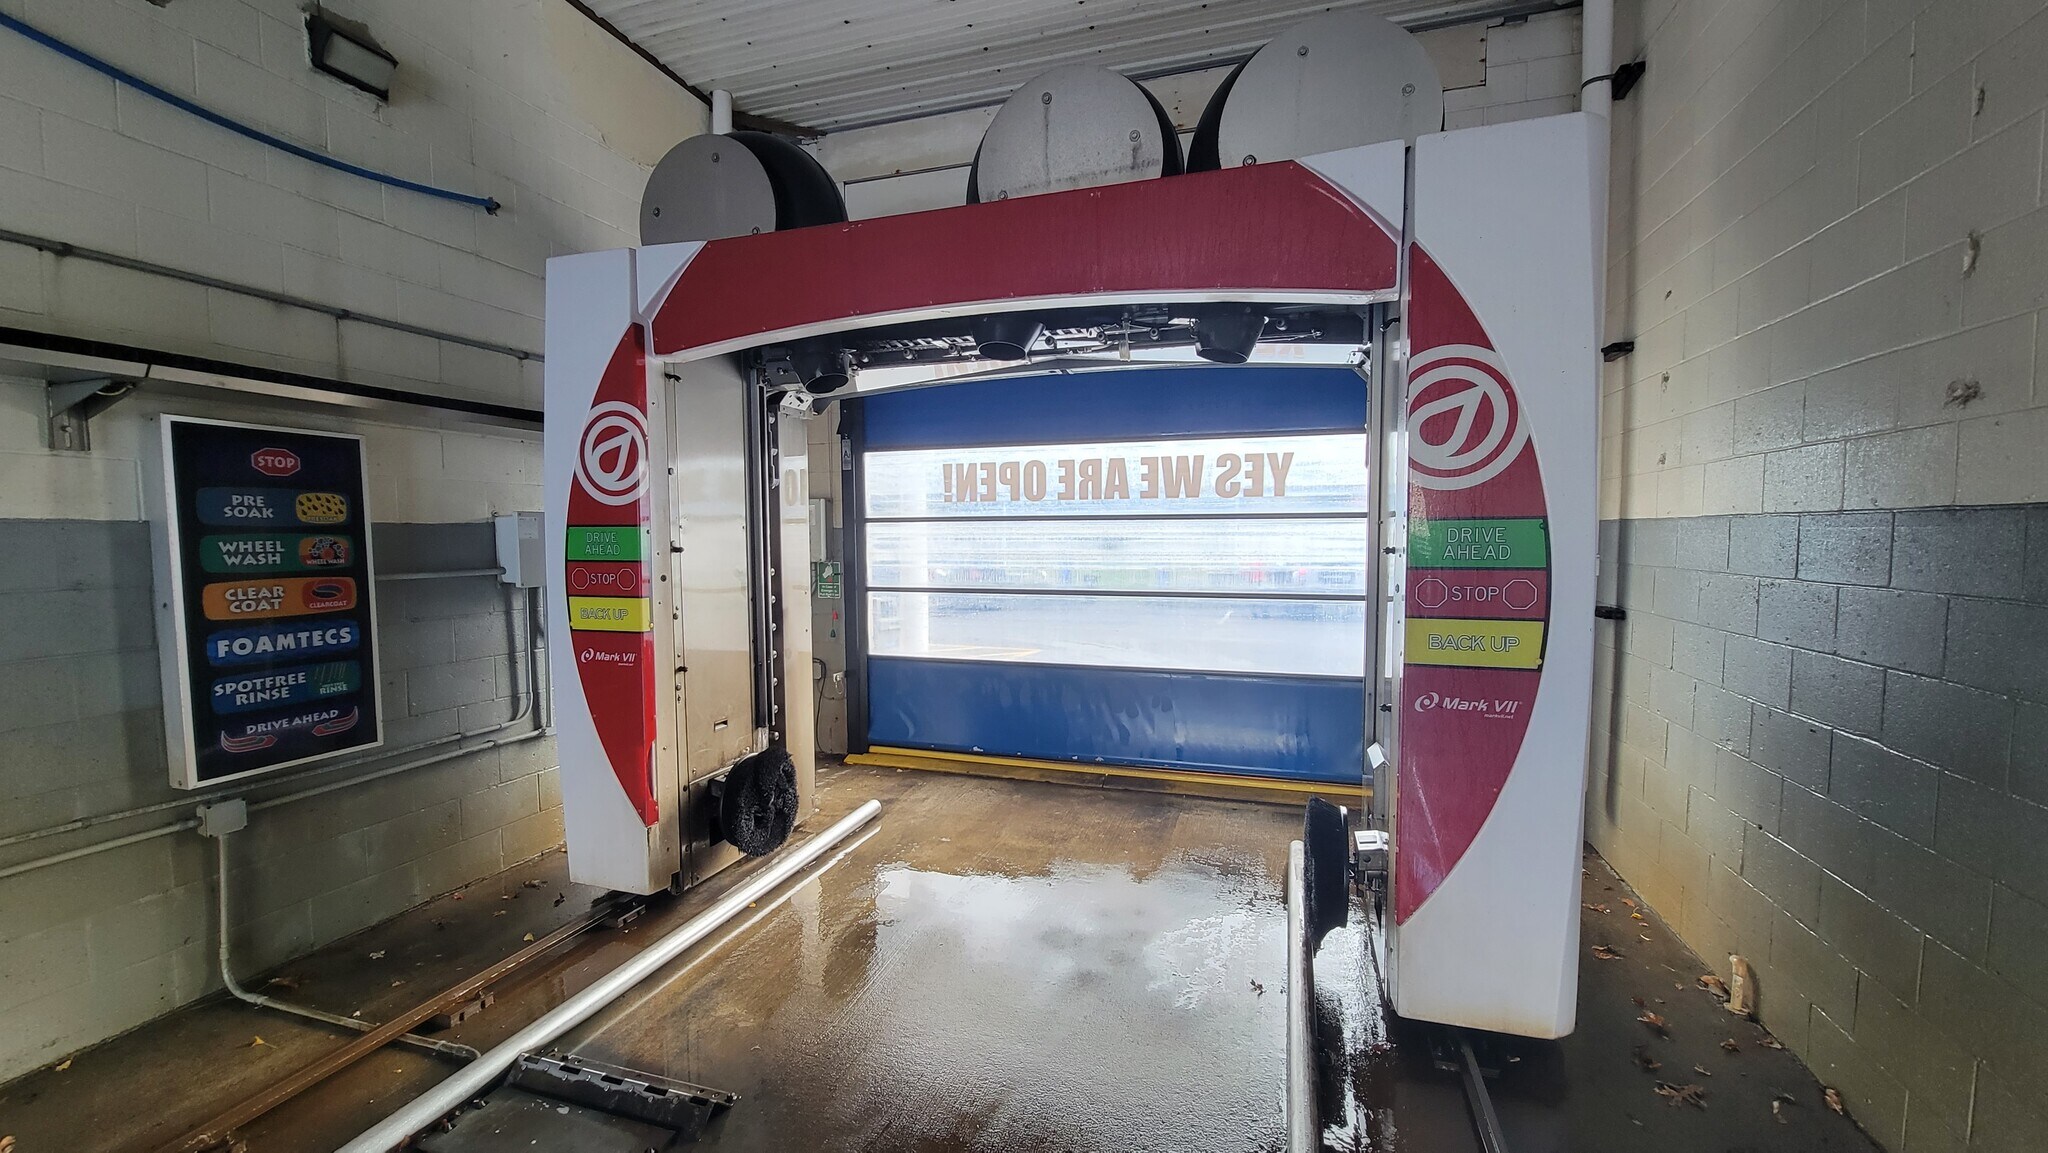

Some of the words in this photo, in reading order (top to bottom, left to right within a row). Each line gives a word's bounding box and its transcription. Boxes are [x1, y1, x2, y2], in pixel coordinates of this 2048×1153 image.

[257, 455, 296, 469] STOP
[232, 494, 265, 508] PRE
[224, 505, 274, 519] SOAK
[586, 532, 617, 543] DRIVE
[1447, 527, 1507, 543] DRIVE
[218, 540, 284, 553] WHEEL
[585, 544, 620, 555] AHEAD
[1442, 545, 1511, 560] AHEAD
[225, 552, 281, 566] WASH
[590, 573, 616, 584] STOP
[225, 586, 284, 601] CLEAR
[1452, 586, 1499, 602] STOP
[229, 599, 281, 613] COAT
[580, 608, 610, 619] BACK
[612, 609, 629, 620] UP
[217, 627, 351, 657] FOAMTECS
[1429, 634, 1485, 651] BACK
[1491, 636, 1520, 652] UP
[595, 652, 620, 661] Mark
[622, 653, 636, 662] VII
[214, 672, 306, 696] SPOTFREE
[319, 683, 348, 694] RINSE
[235, 687, 290, 706] RINSE
[1442, 697, 1489, 711] Mark
[1494, 700, 1519, 713] VII
[246, 719, 288, 735] DRIVE
[291, 709, 339, 726] AHEAD
